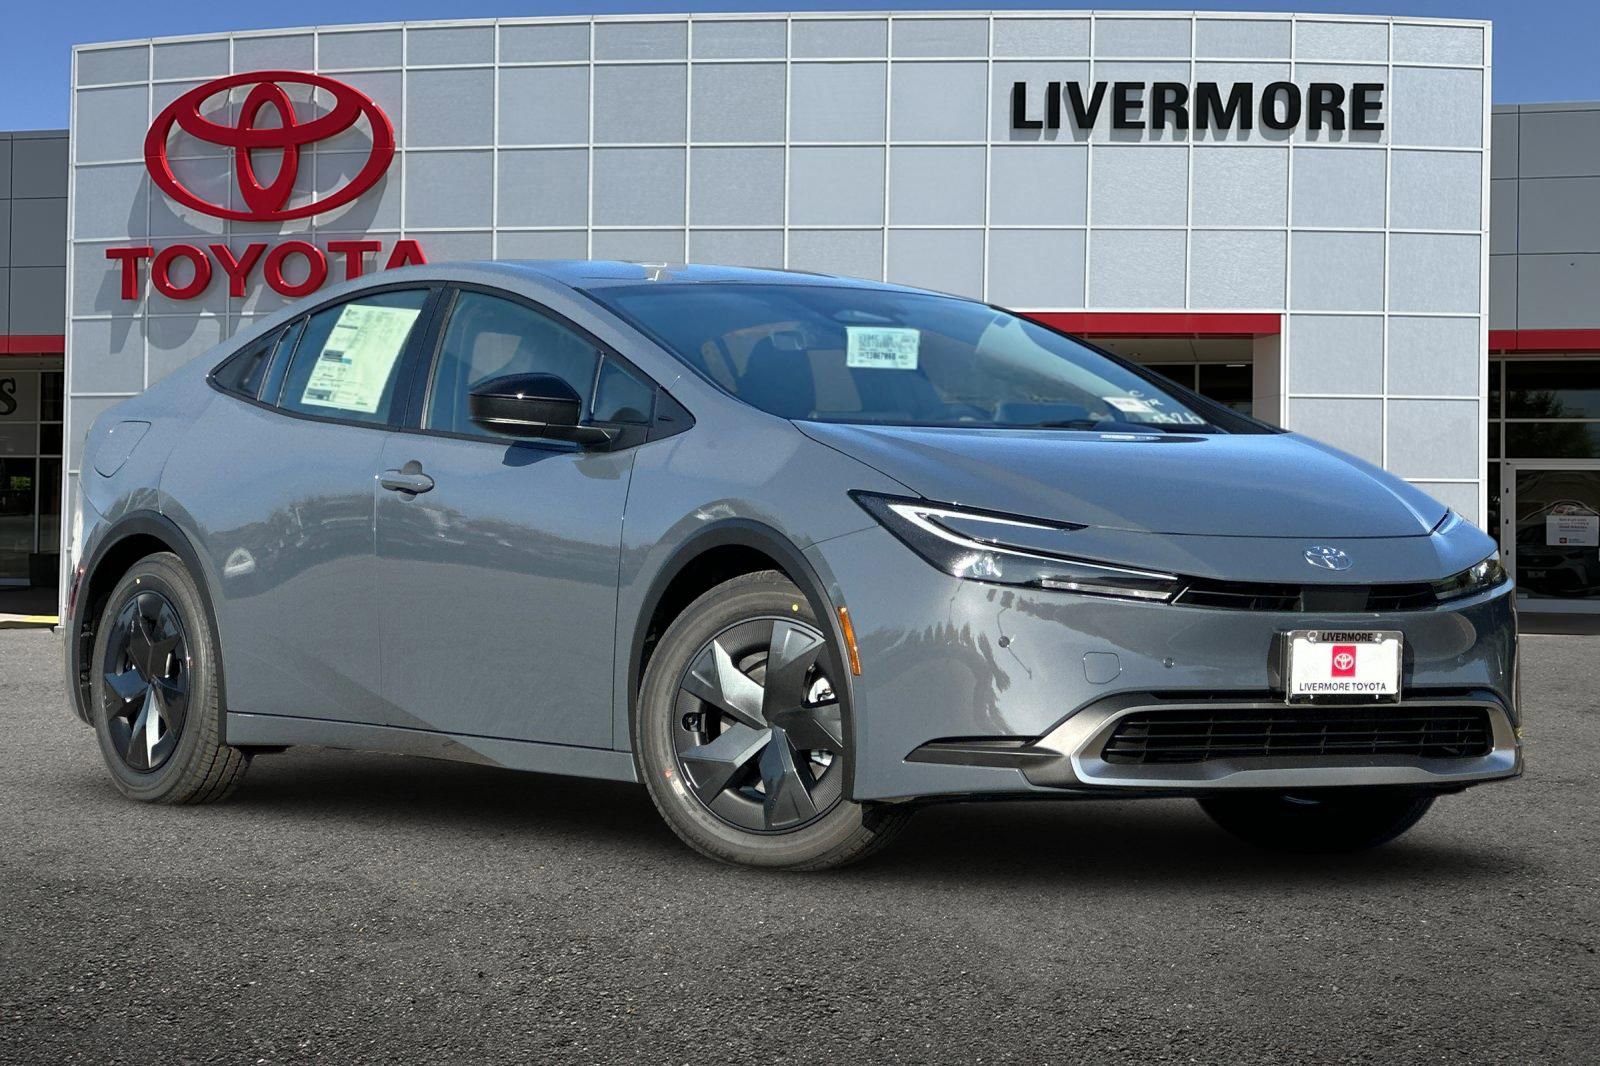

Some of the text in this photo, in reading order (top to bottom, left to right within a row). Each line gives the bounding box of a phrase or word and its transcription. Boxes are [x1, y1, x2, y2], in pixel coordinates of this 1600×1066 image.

[1012, 80, 1385, 131] LIVERMORE
[1321, 632, 1374, 642] LIVERMORE
[1299, 682, 1387, 692] LIVERMORE TOYOTA
